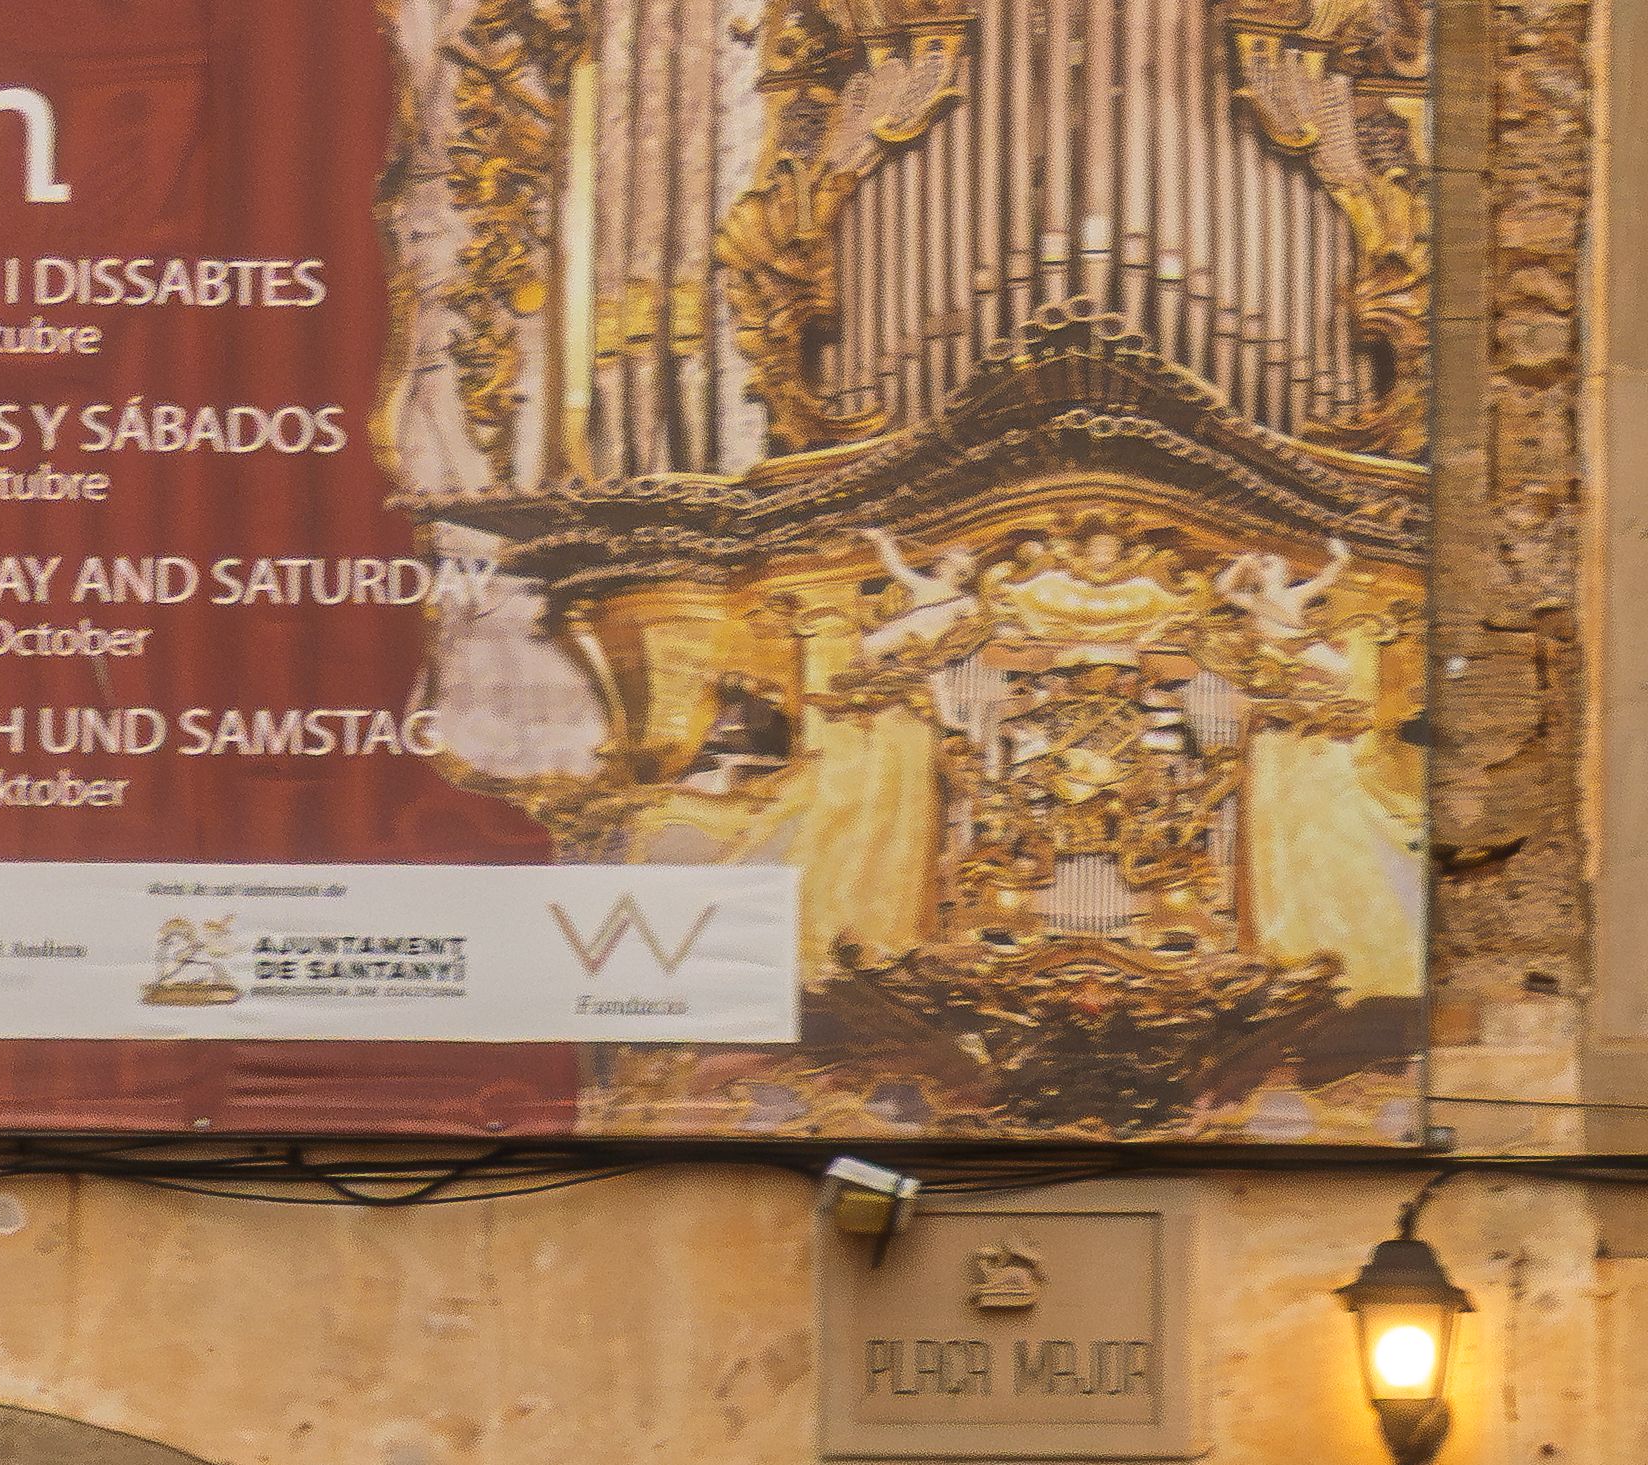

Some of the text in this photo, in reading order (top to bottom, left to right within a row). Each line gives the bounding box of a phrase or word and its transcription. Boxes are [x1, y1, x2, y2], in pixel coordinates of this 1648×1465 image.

[4, 257, 20, 304] I
[33, 256, 327, 308] DISSABTES
[31, 402, 69, 452] Y
[79, 395, 348, 455] SÁBADOS
[71, 556, 199, 605] AND
[211, 556, 500, 607] SATURDAY
[38, 707, 167, 756] UND
[178, 707, 444, 758] SAMSTAG
[253, 936, 467, 955] AJUNTAMENT
[255, 961, 297, 980] DE
